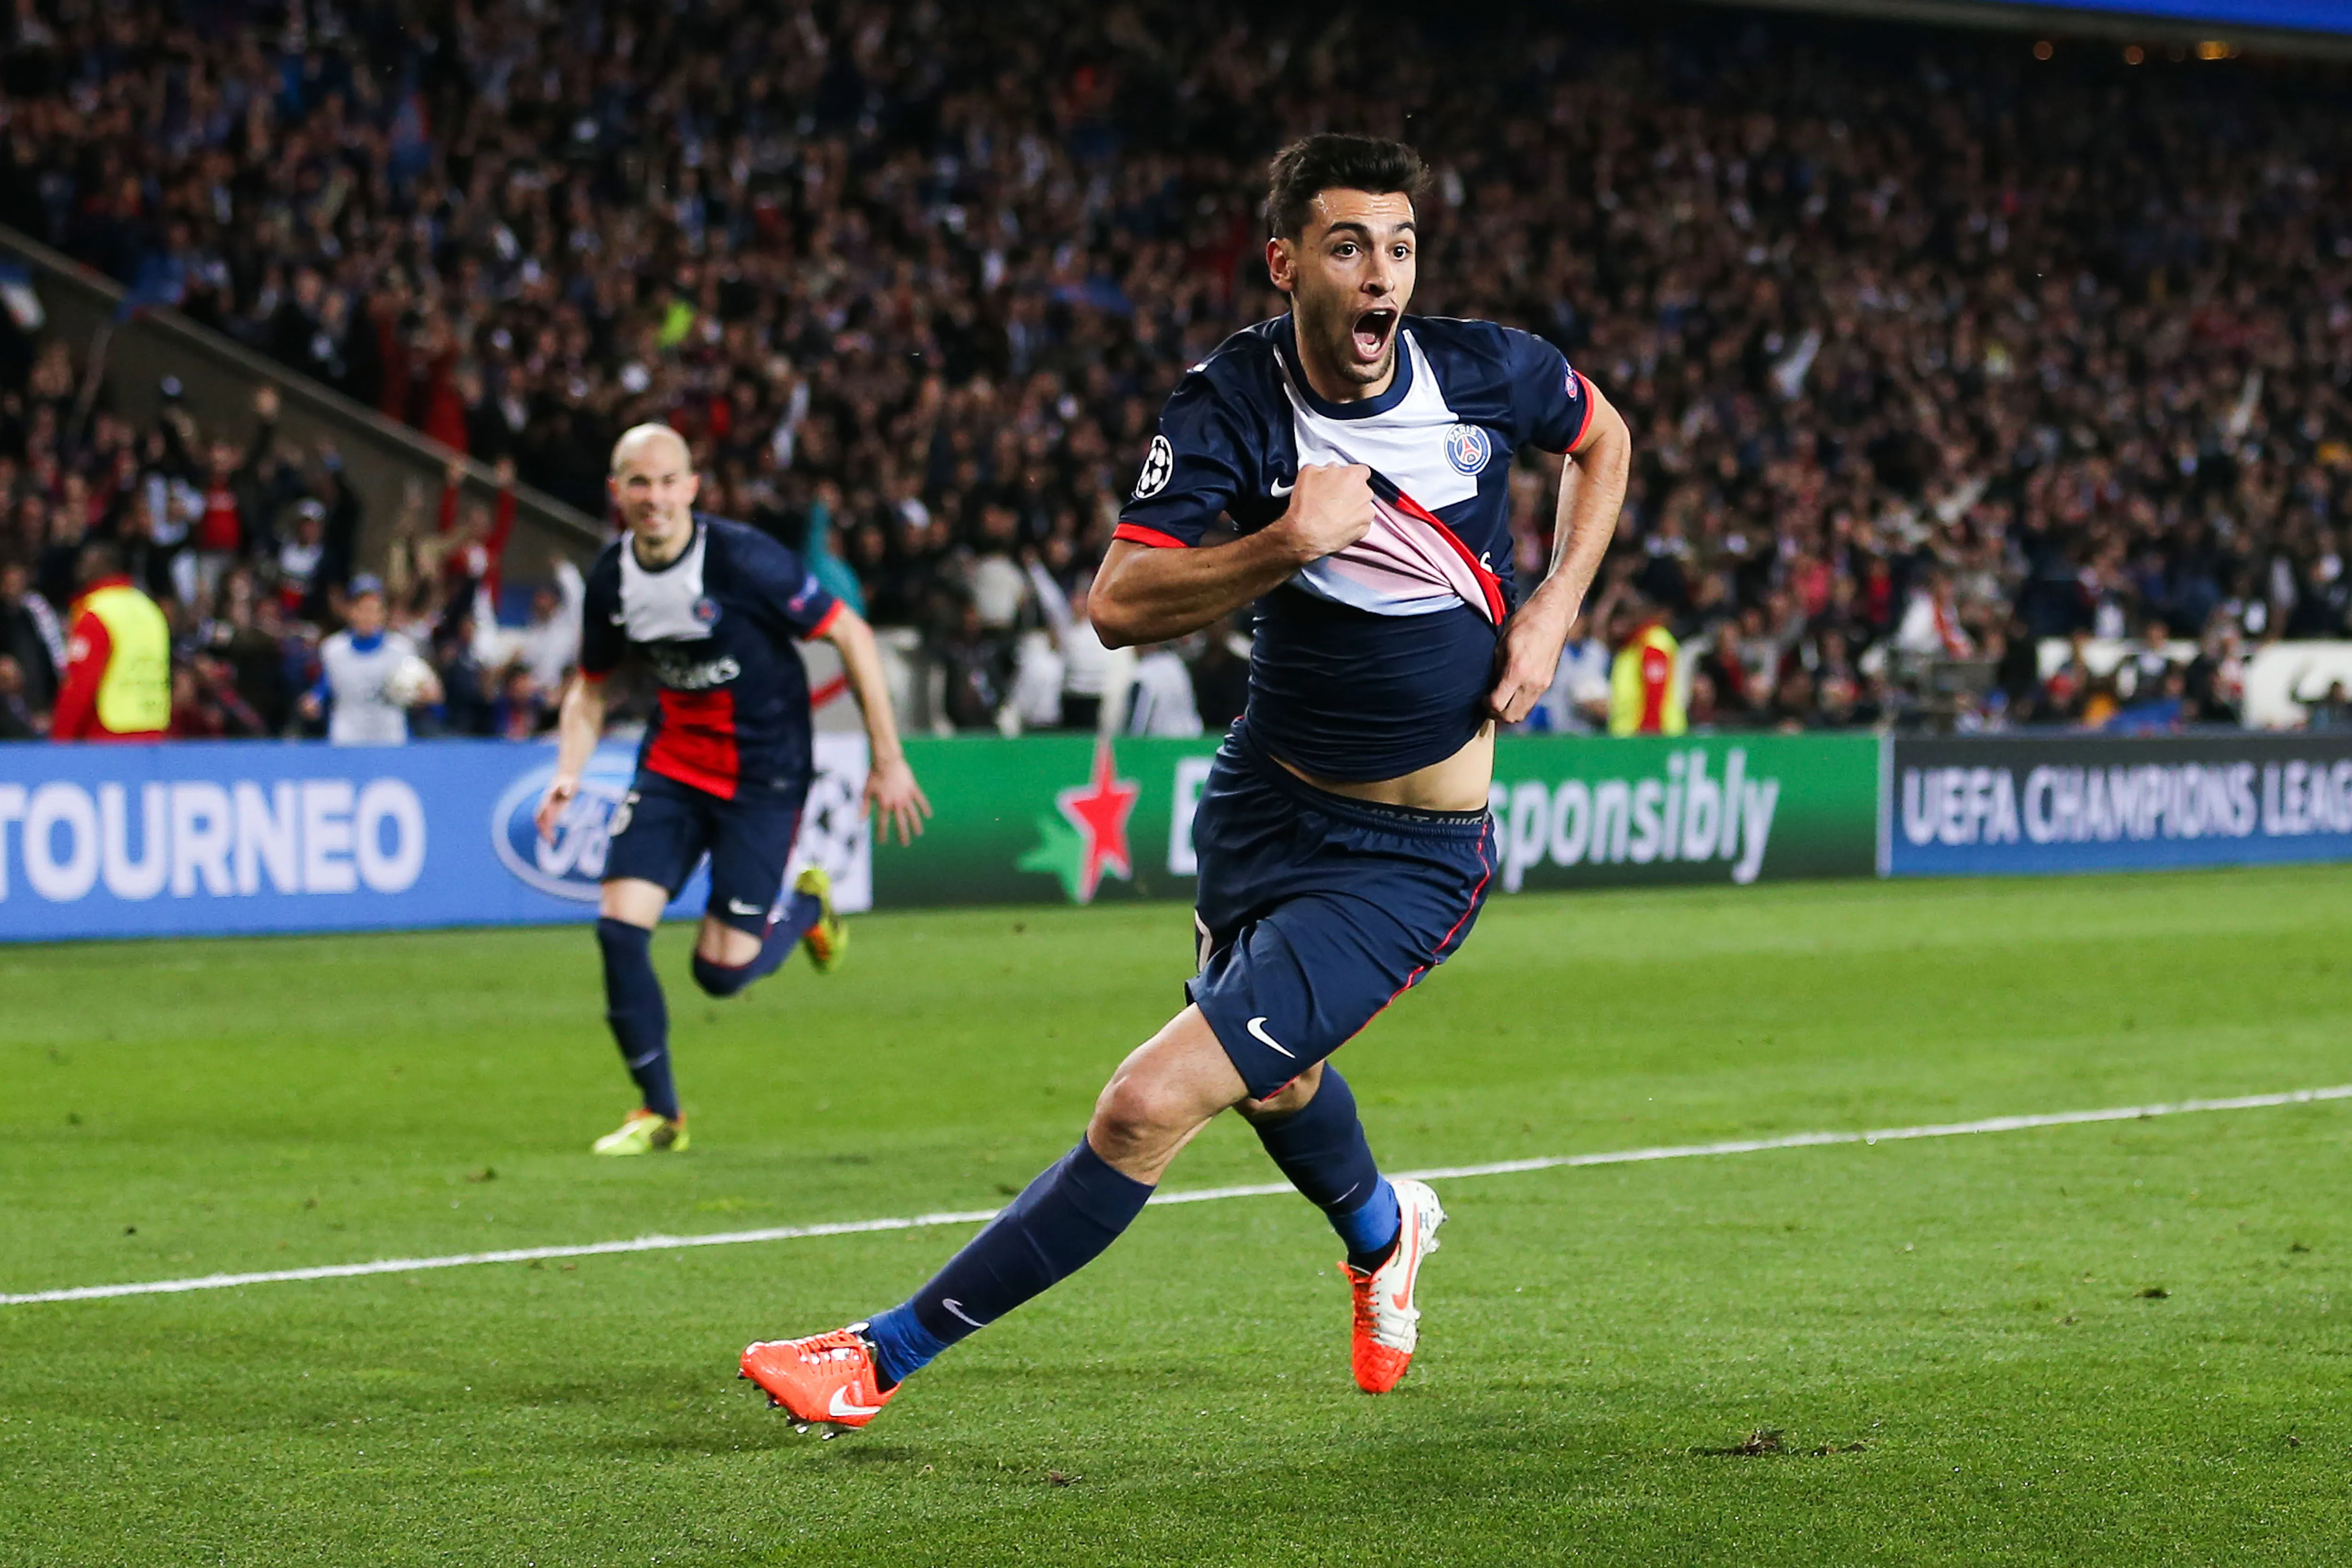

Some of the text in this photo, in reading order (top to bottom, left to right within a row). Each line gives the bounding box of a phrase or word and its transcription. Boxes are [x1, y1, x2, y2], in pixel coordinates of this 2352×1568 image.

[1448, 425, 1477, 443] PARIS
[1488, 750, 1779, 893] sponsibly
[1902, 766, 2020, 845] UEFA
[2024, 760, 2257, 844] CHAMPIONS
